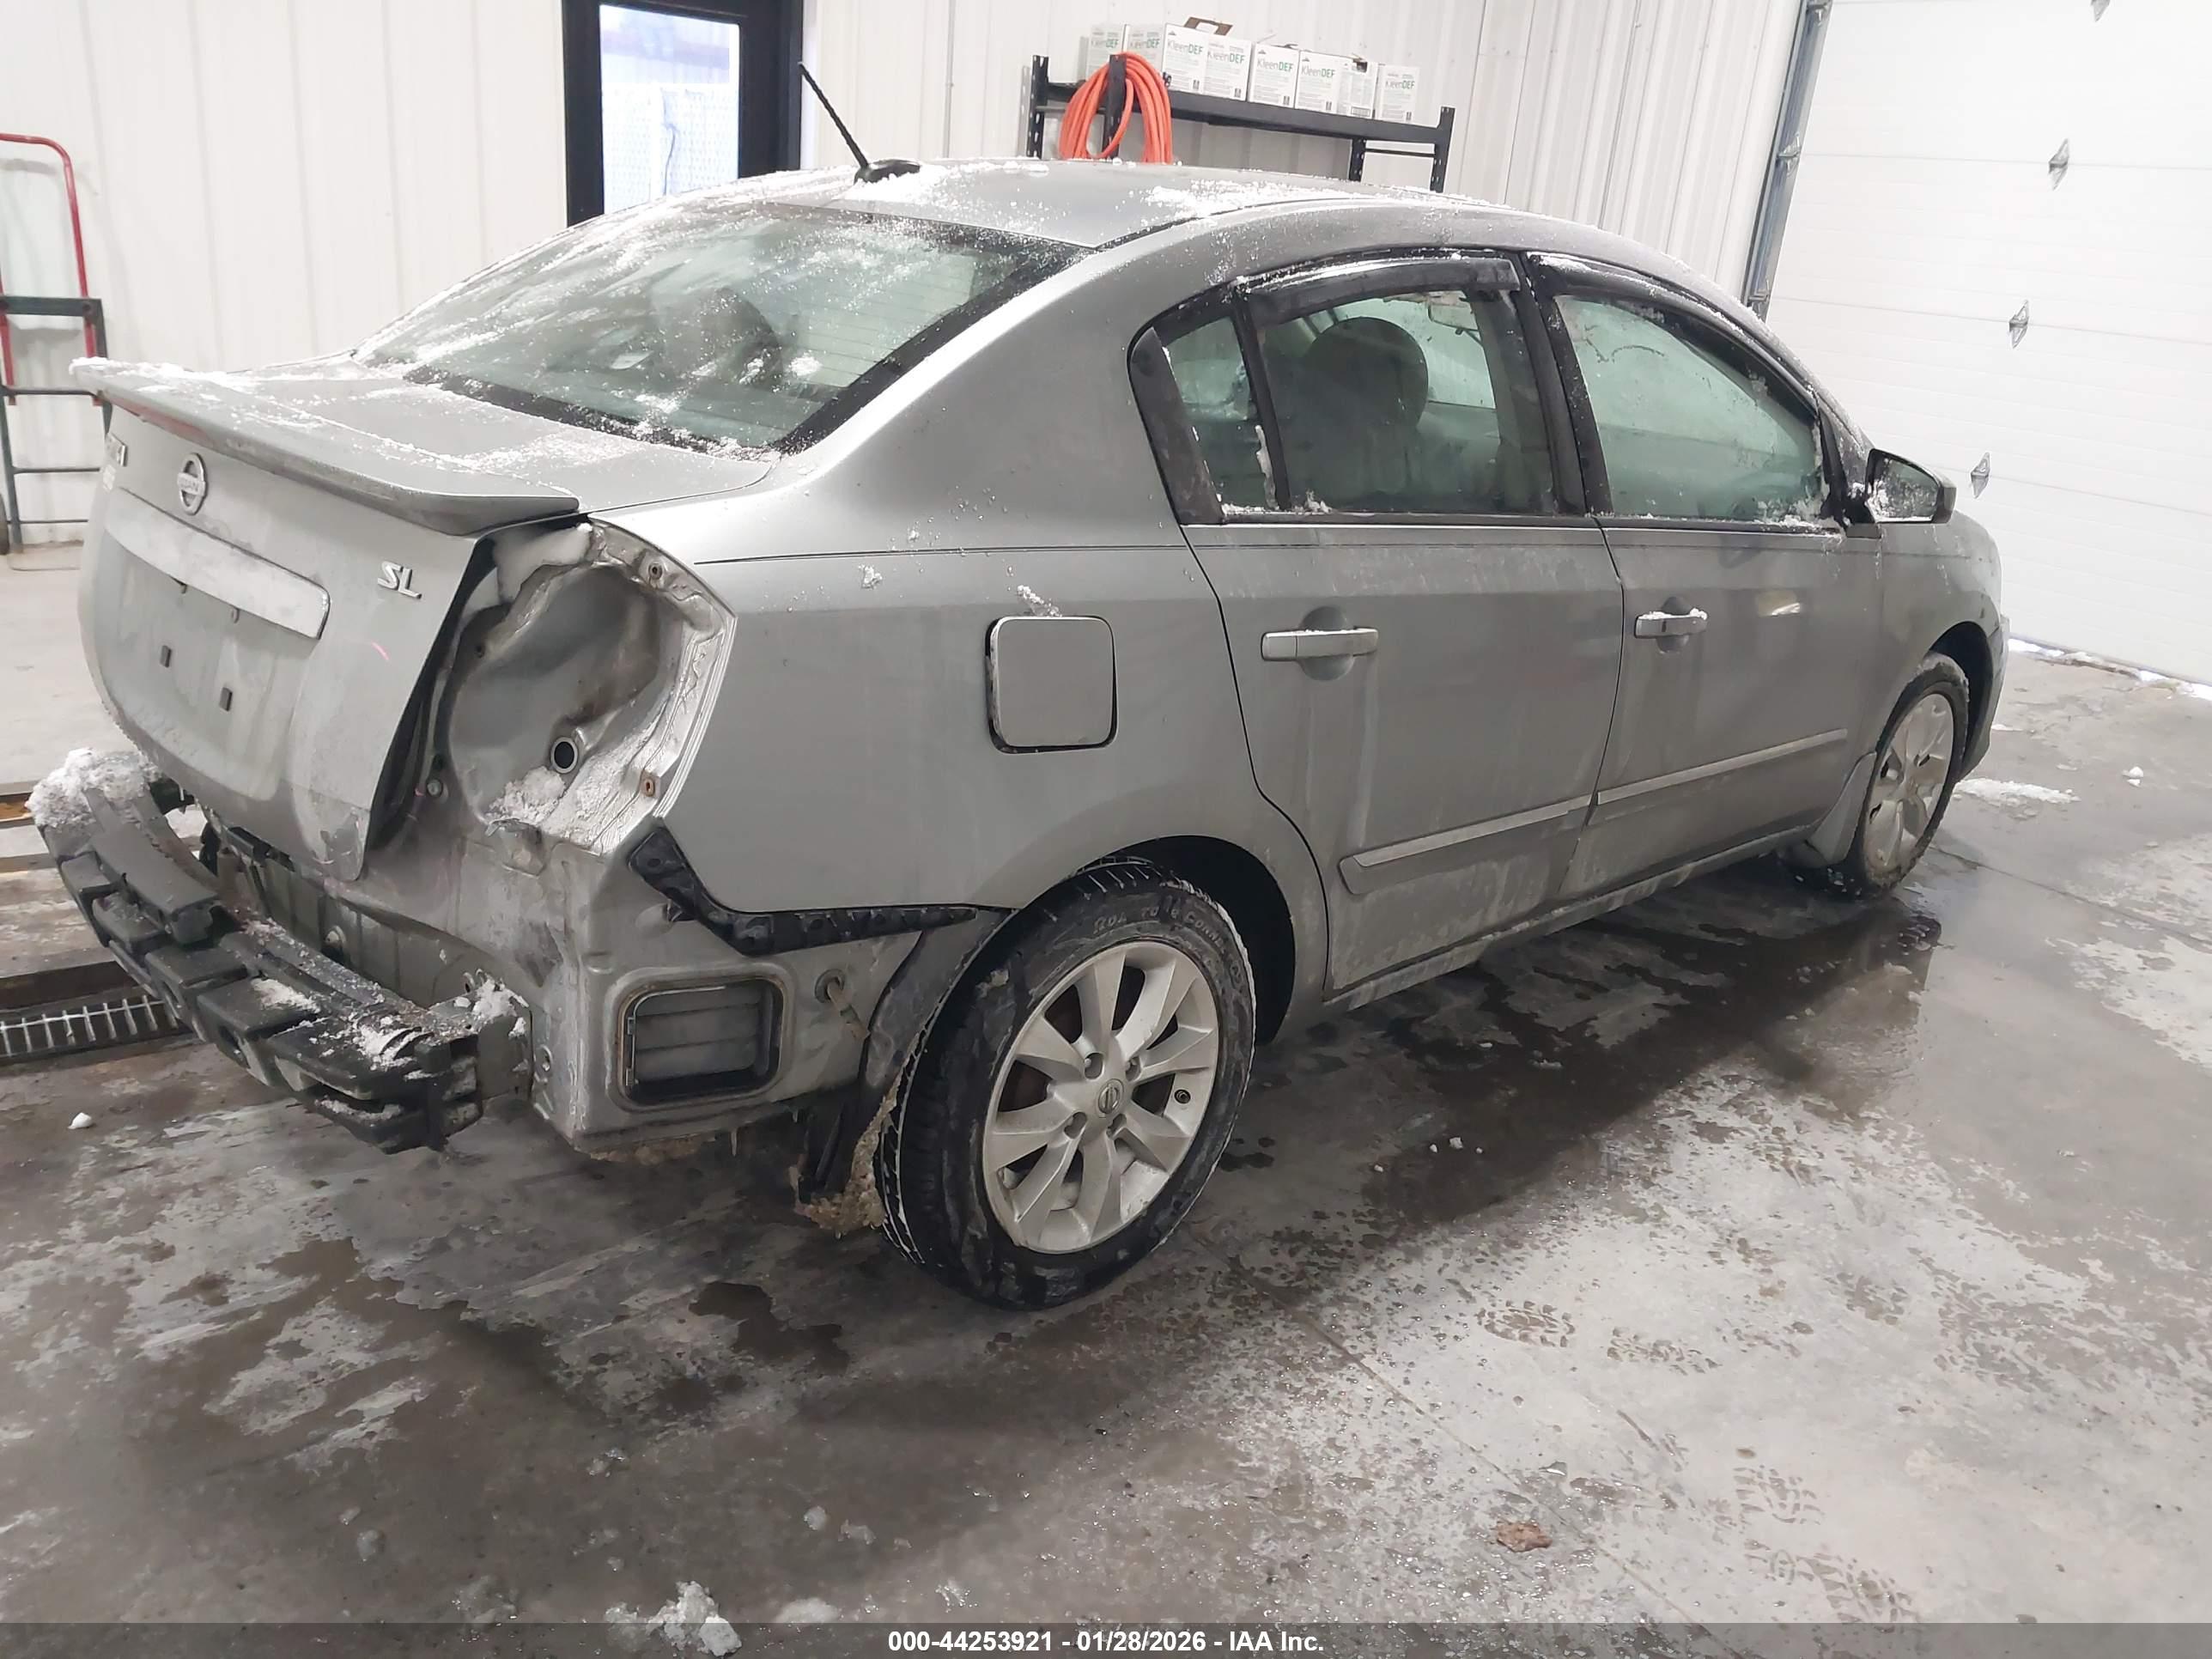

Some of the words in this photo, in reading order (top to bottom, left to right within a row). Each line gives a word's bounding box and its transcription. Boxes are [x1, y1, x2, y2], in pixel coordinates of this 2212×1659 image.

[1167, 40, 1204, 55] KleenDEF
[1256, 58, 1294, 72] KleenDEF
[1300, 66, 1336, 79] KleenDEF
[378, 561, 422, 599] SL
